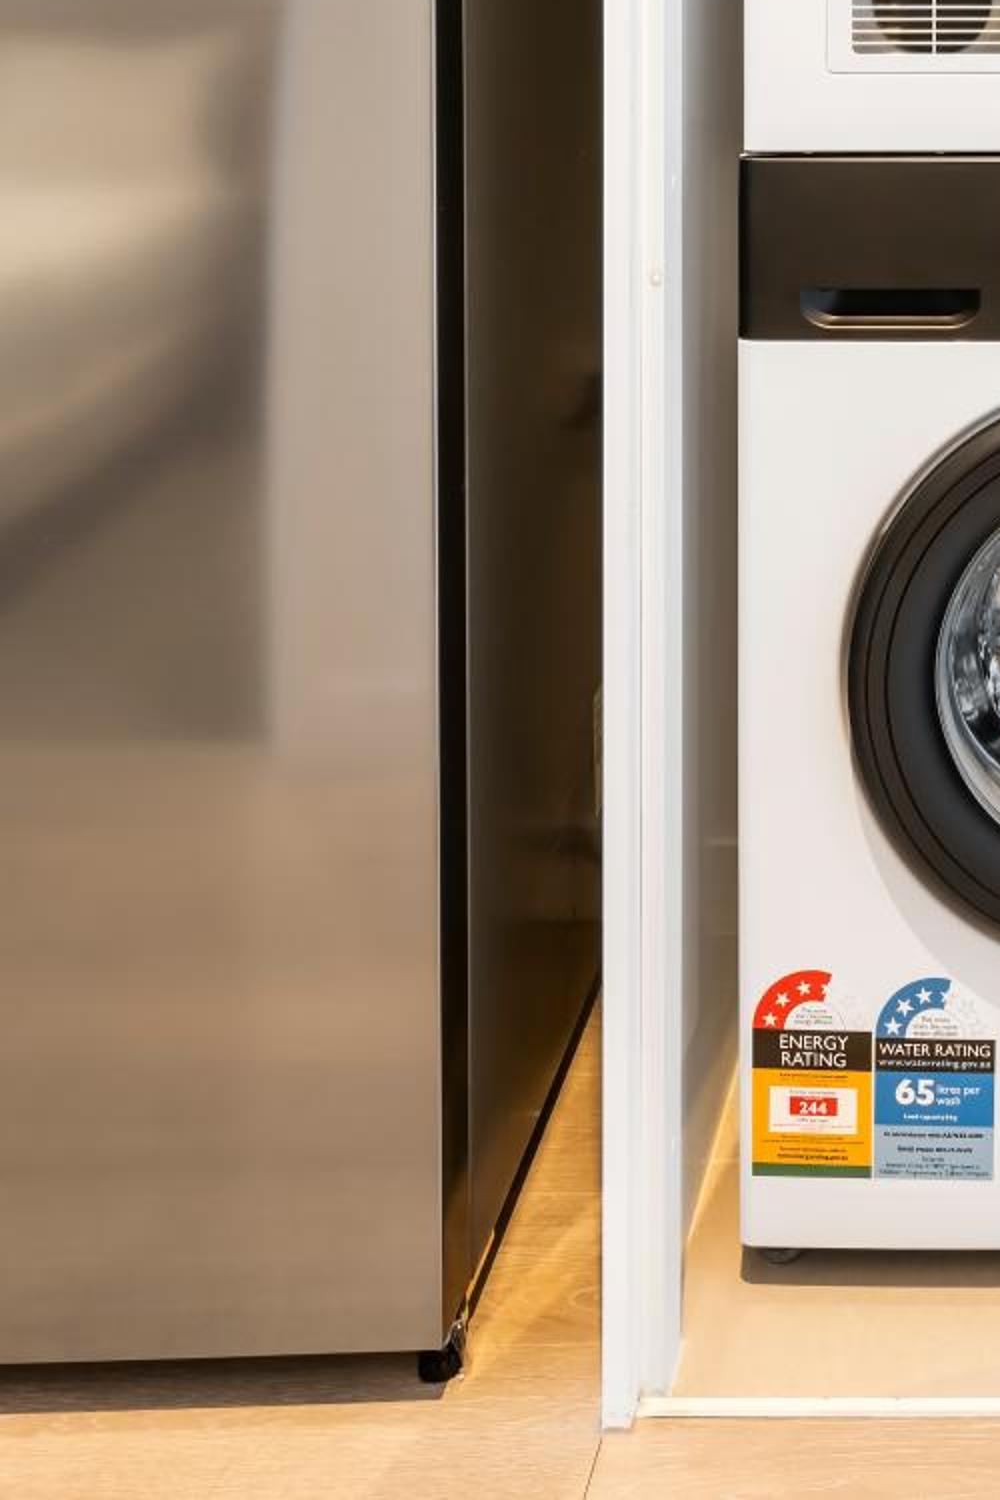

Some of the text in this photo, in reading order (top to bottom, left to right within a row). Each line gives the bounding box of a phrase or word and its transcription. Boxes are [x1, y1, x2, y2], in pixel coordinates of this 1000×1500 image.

[779, 1033, 849, 1051] ENERGY
[880, 1043, 991, 1058] WATER RATING
[781, 1051, 847, 1068] RATING
[895, 1078, 935, 1106] 65
[963, 1086, 981, 1098] per
[799, 1101, 829, 1115] 244
